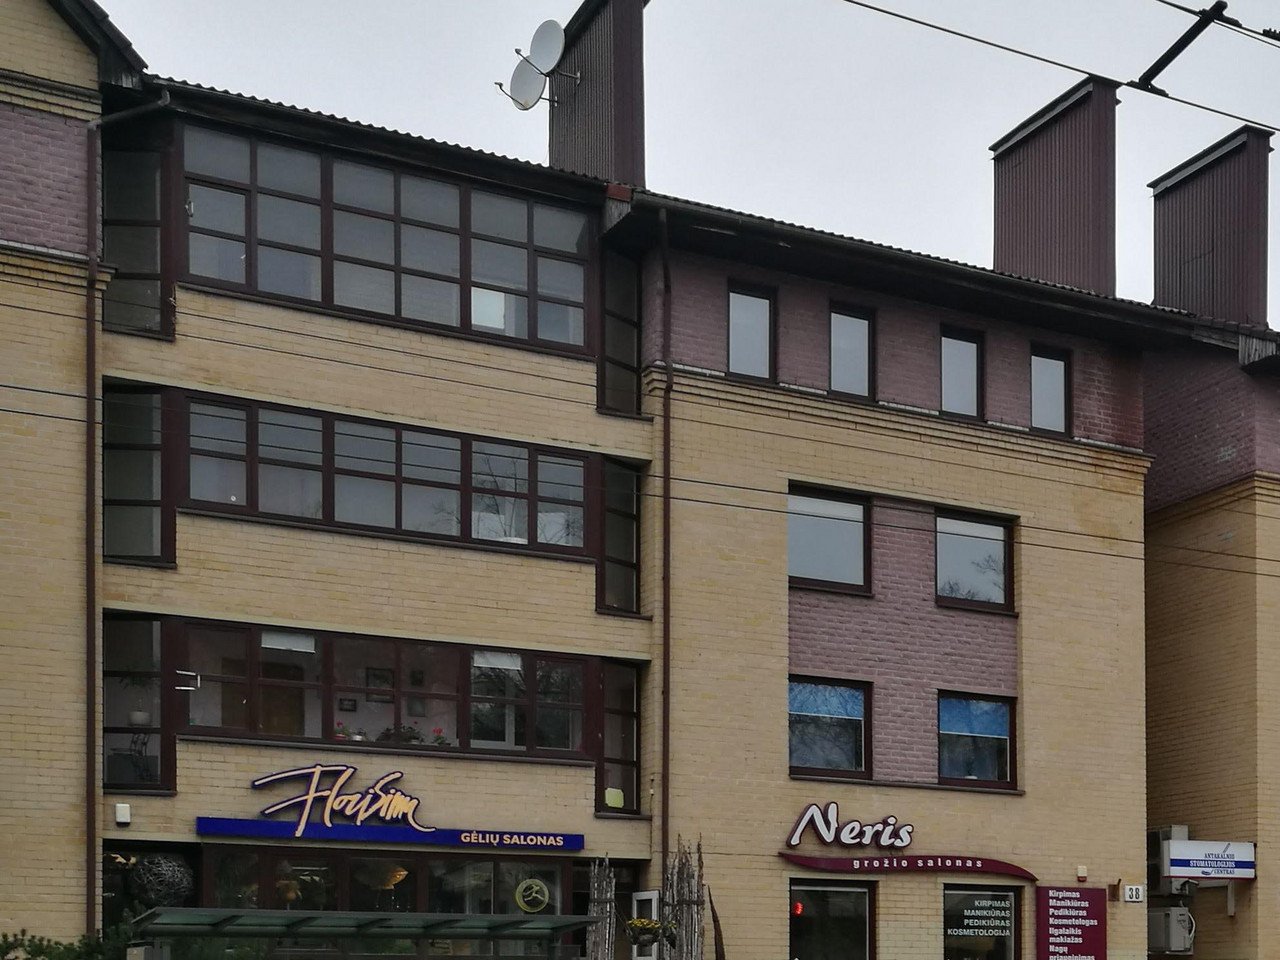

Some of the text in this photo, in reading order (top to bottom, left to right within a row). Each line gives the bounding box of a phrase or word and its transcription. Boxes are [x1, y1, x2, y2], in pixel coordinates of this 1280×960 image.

[787, 802, 914, 848] Neris
[460, 830, 564, 847] GĖLIŲ SALONAS
[853, 857, 983, 870] grožio salonas
[1128, 887, 1140, 900] 38
[974, 899, 1011, 908] KIRPIMAS
[963, 908, 1011, 917] MANIKIŪRAS
[963, 918, 1011, 927] PEDIKIŪRAS
[947, 928, 1011, 937] KOSMETOLOGIJA
